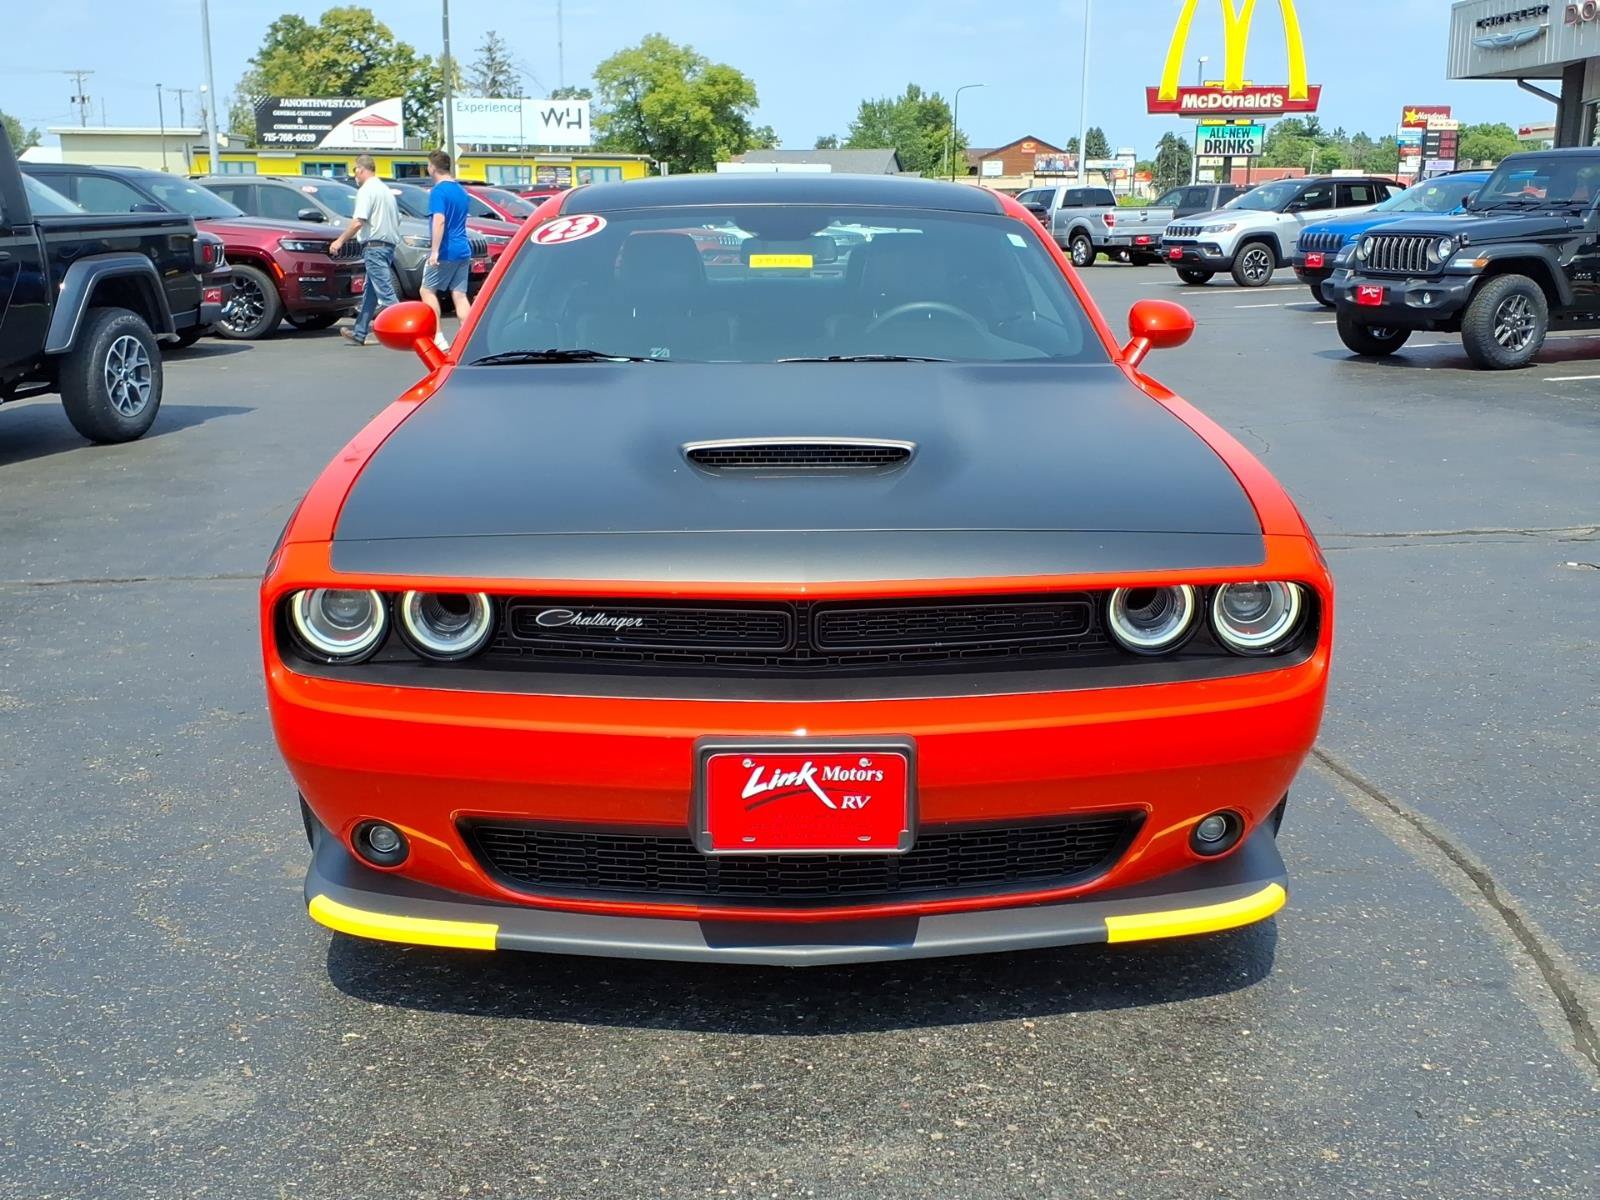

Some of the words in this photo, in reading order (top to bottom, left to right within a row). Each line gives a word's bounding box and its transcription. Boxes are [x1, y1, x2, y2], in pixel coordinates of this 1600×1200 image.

[280, 98, 366, 108] JANORTHWEST.COM
[456, 101, 522, 113] Experience
[1181, 93, 1283, 109] McDonald's
[1209, 127, 1251, 138] ALL-NEW
[1204, 139, 1254, 154] DRINKS
[535, 609, 643, 632] Challenger
[741, 761, 838, 809] Link
[821, 766, 884, 782] Motors
[841, 795, 871, 809] RV
